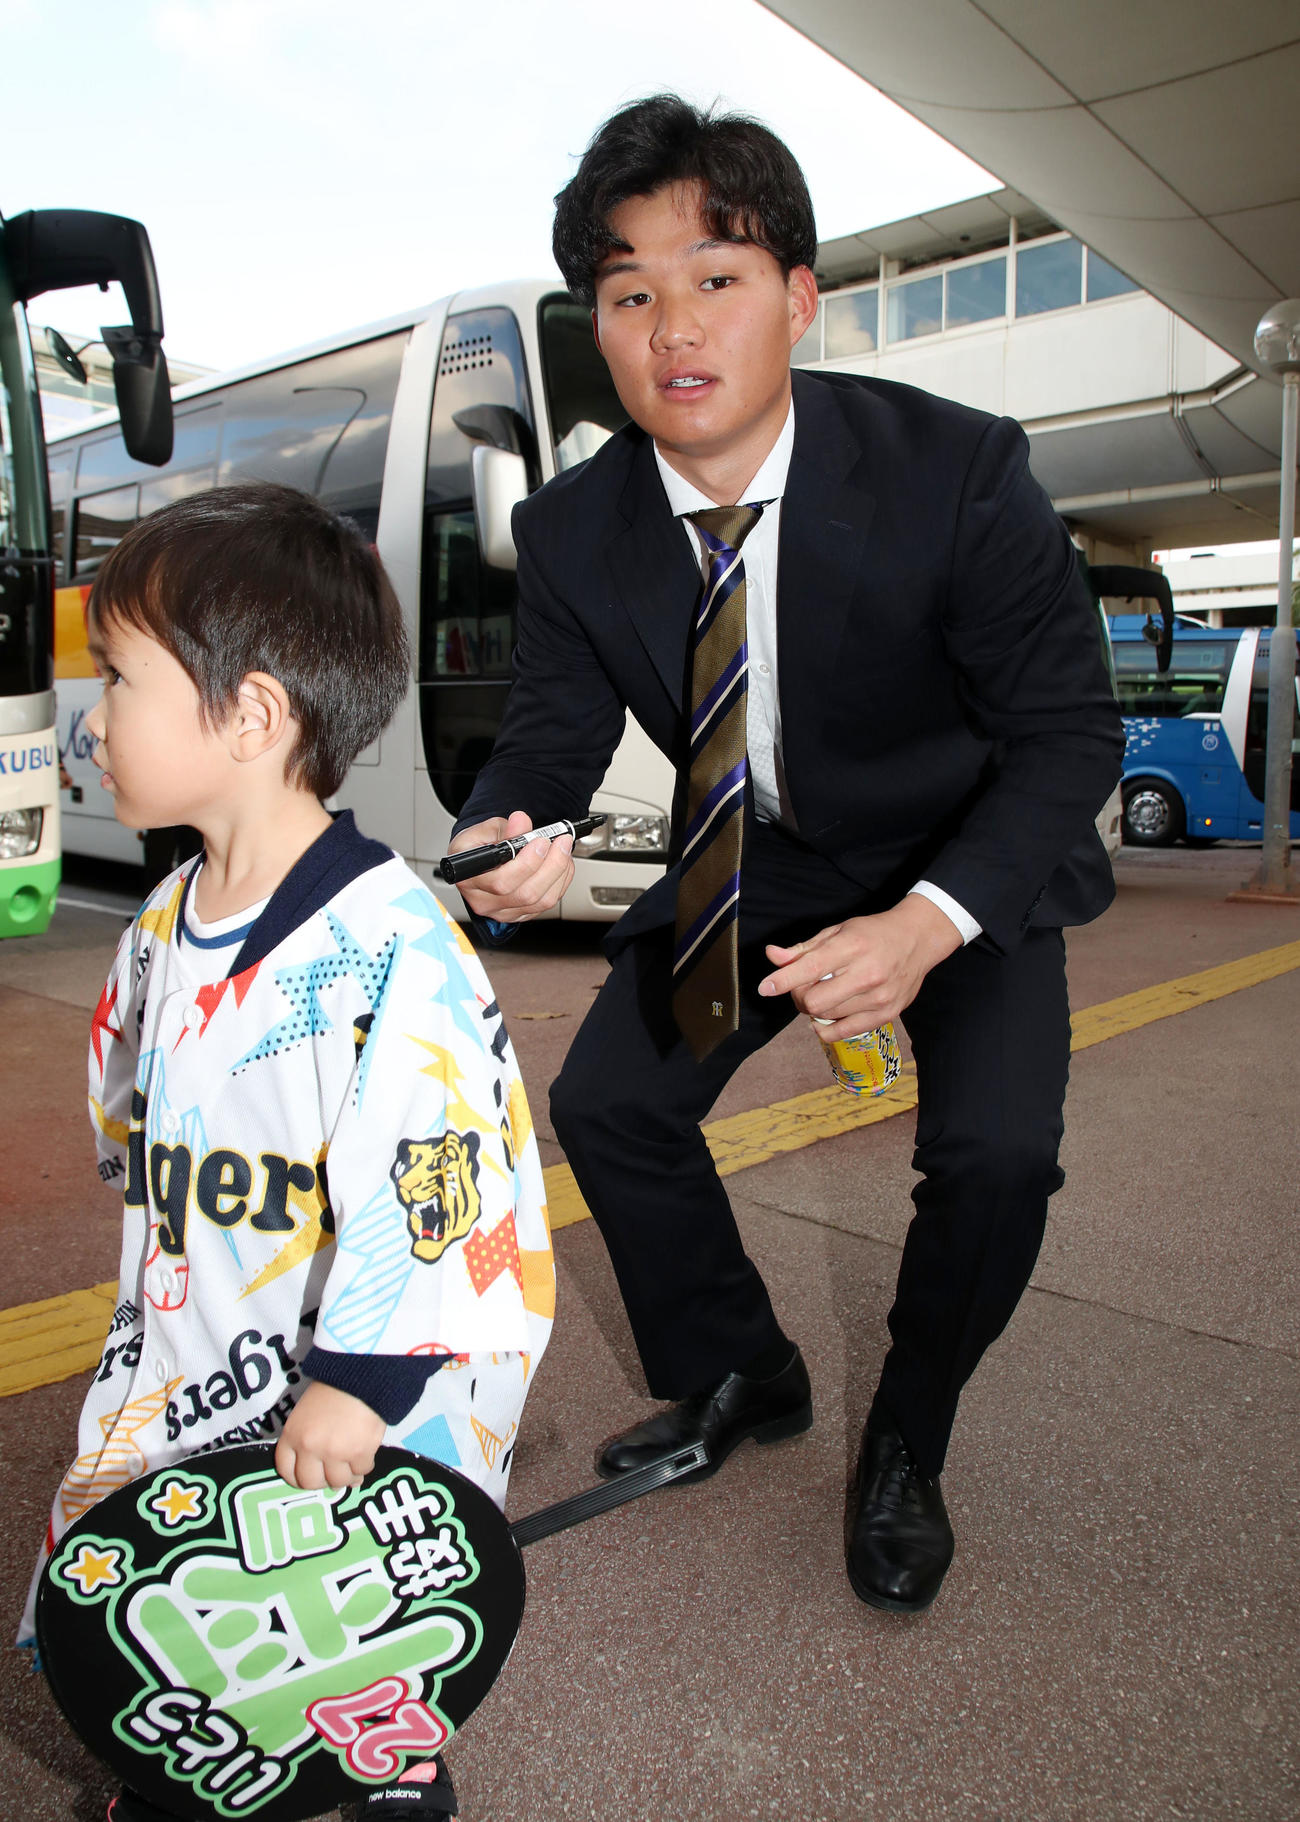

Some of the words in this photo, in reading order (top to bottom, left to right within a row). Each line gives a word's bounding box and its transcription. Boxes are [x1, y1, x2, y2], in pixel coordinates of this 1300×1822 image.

[123, 1087, 335, 1258] iger
[165, 1307, 320, 1442] igers
[363, 1479, 467, 1599] 投手
[129, 1691, 282, 1807] いとう
[306, 1676, 449, 1779] 27
[385, 1787, 422, 1799] balance
